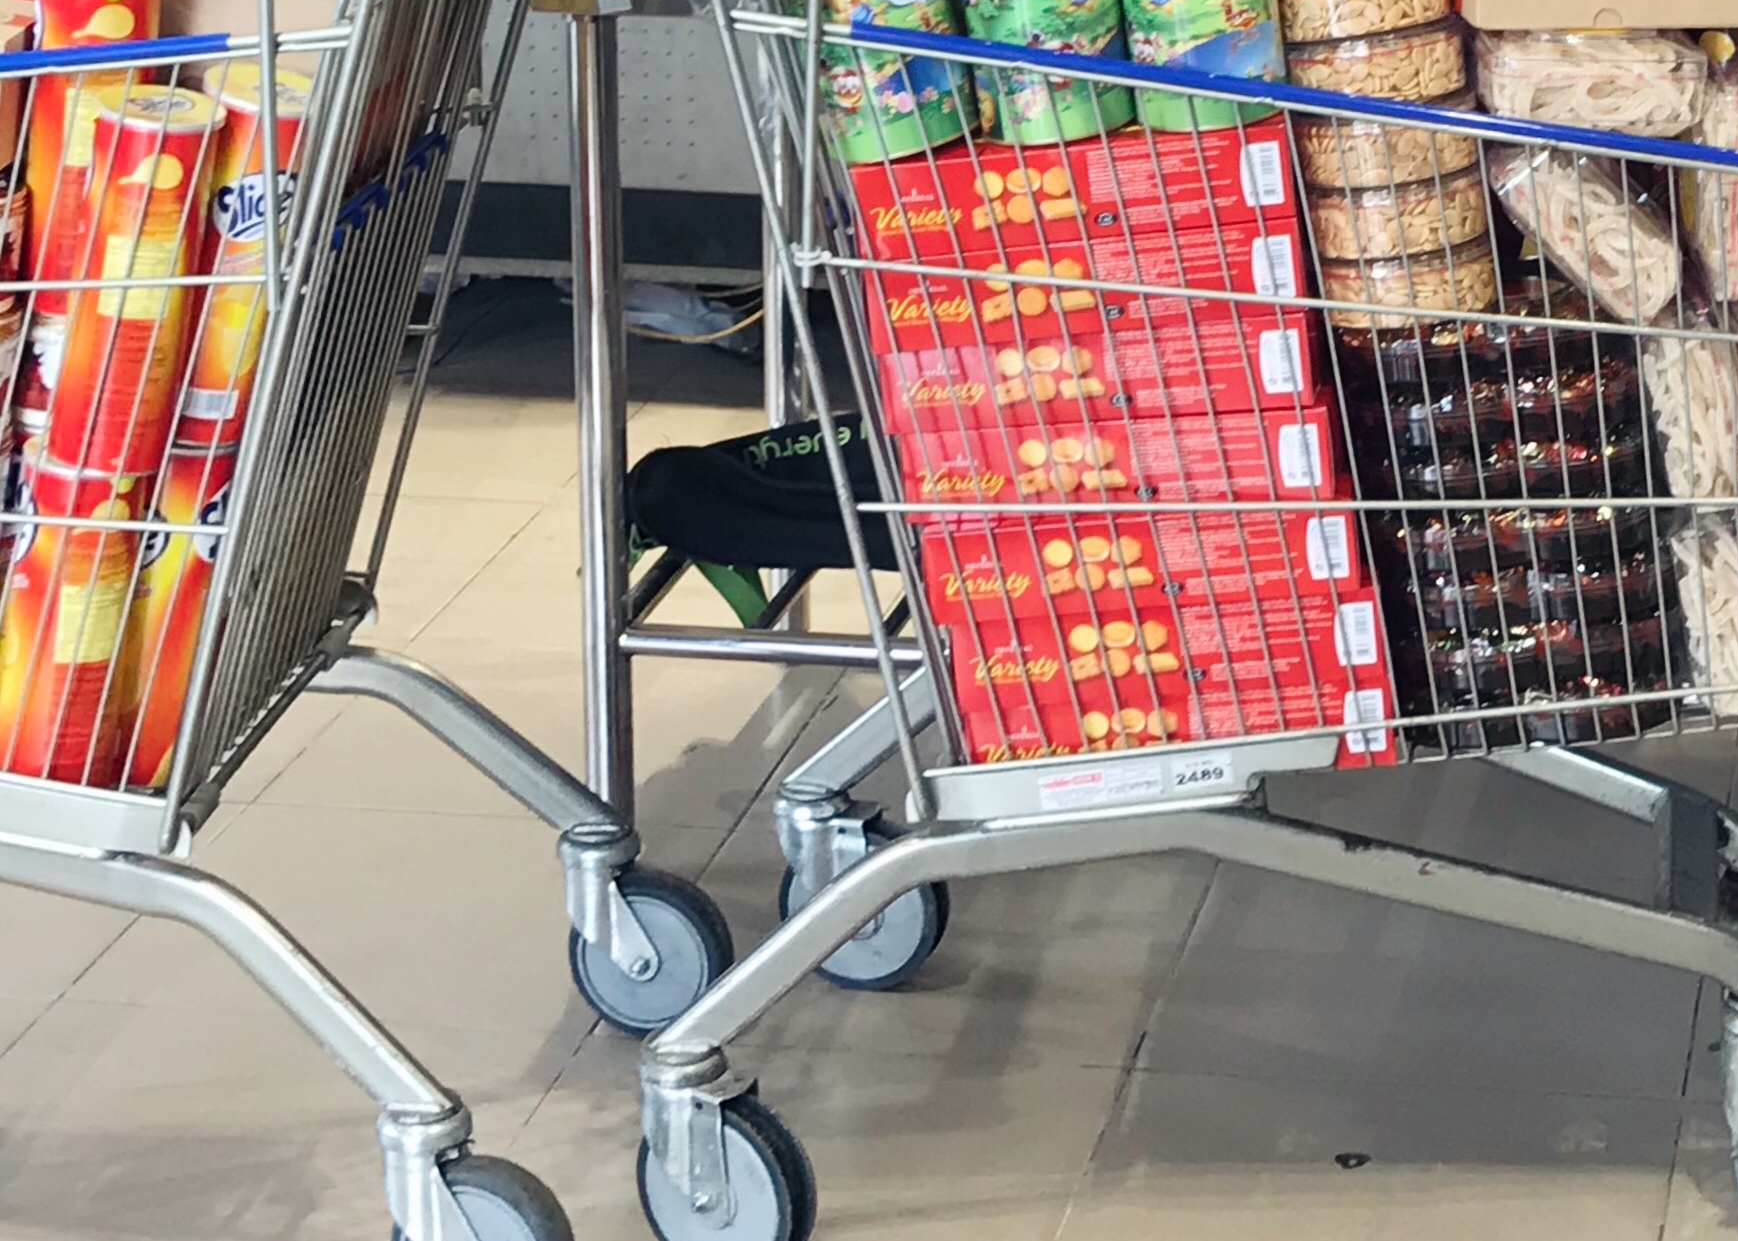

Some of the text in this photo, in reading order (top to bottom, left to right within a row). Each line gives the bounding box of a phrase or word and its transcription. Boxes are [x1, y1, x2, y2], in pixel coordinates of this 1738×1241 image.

[869, 204, 964, 230] Variety
[886, 292, 974, 323] Variety
[900, 376, 986, 405] Variety
[917, 467, 1006, 494] Variety
[939, 571, 1032, 597] Variety
[971, 651, 1060, 679] Variety
[1174, 766, 1226, 786] 2489
